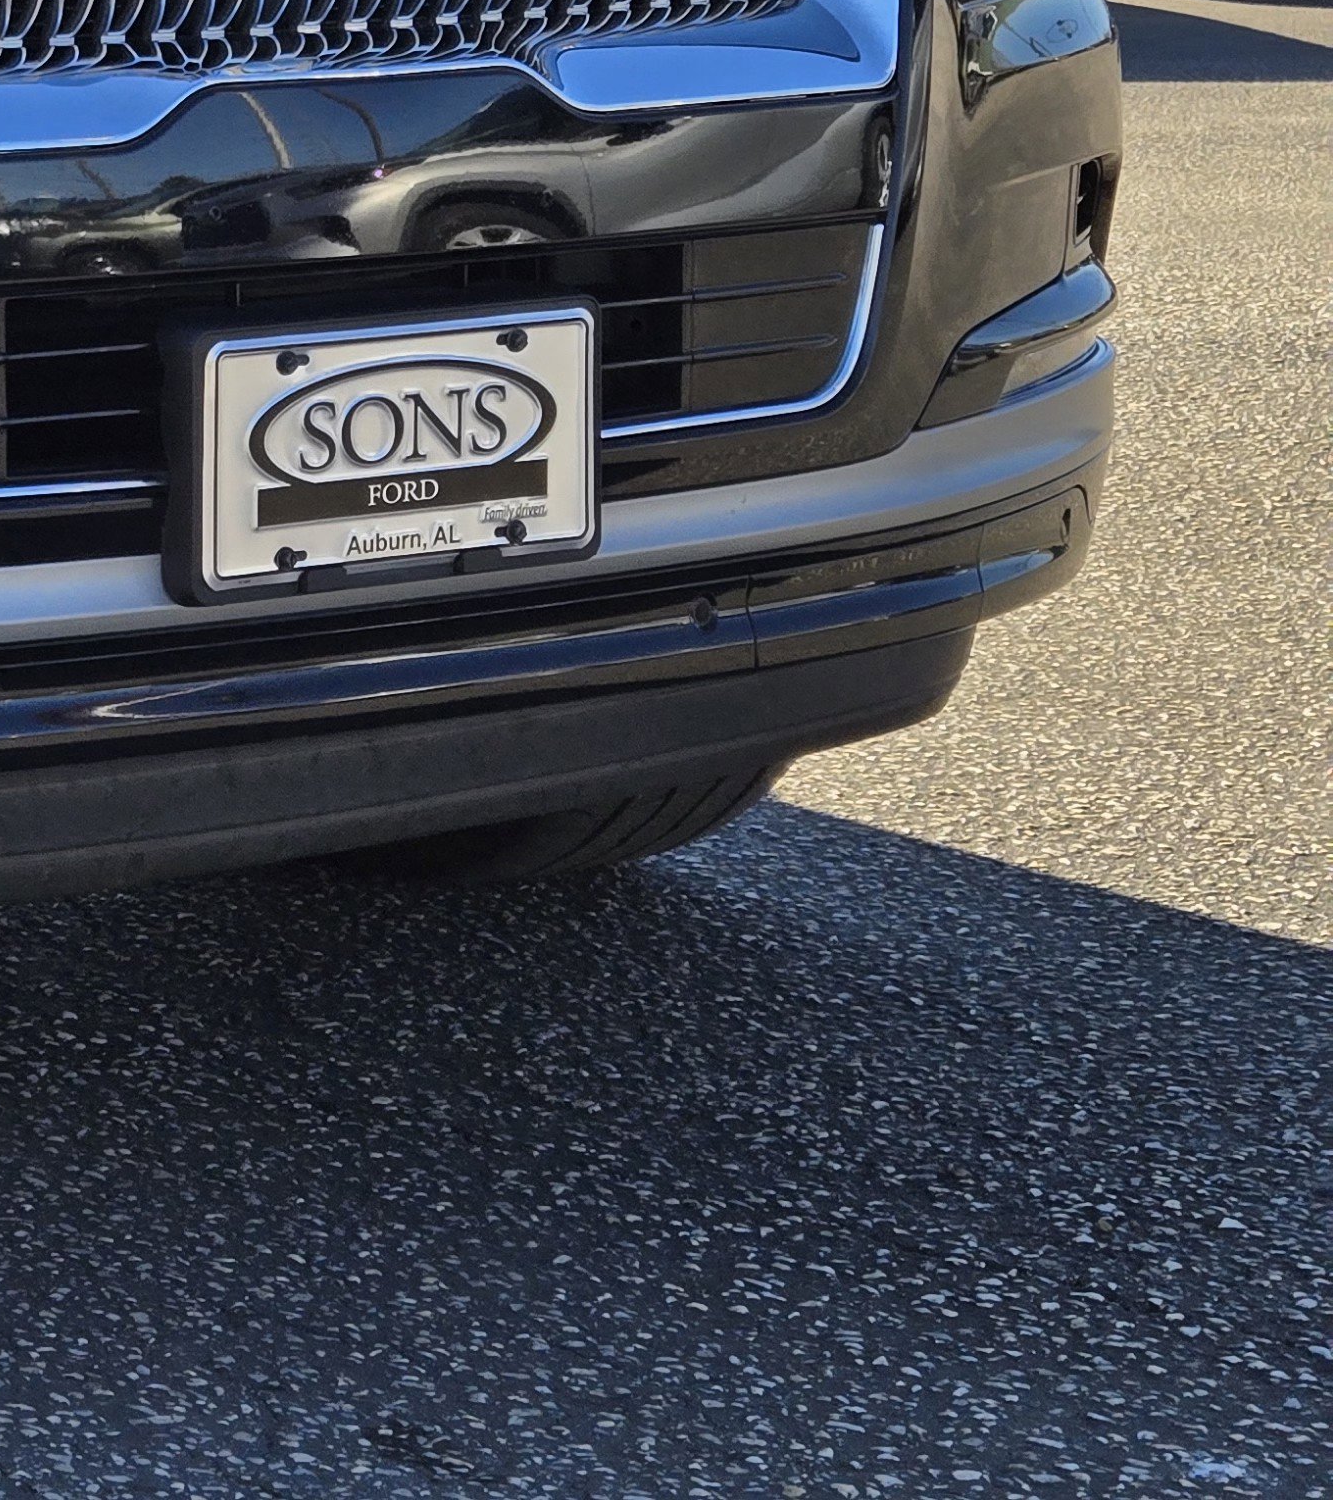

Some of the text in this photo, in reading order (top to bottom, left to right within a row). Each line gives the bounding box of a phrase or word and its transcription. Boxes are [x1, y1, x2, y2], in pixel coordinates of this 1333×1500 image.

[299, 384, 508, 473] SONS
[367, 479, 439, 507] FORD
[483, 505, 514, 522] Family
[346, 524, 461, 556] Auburn, AL
